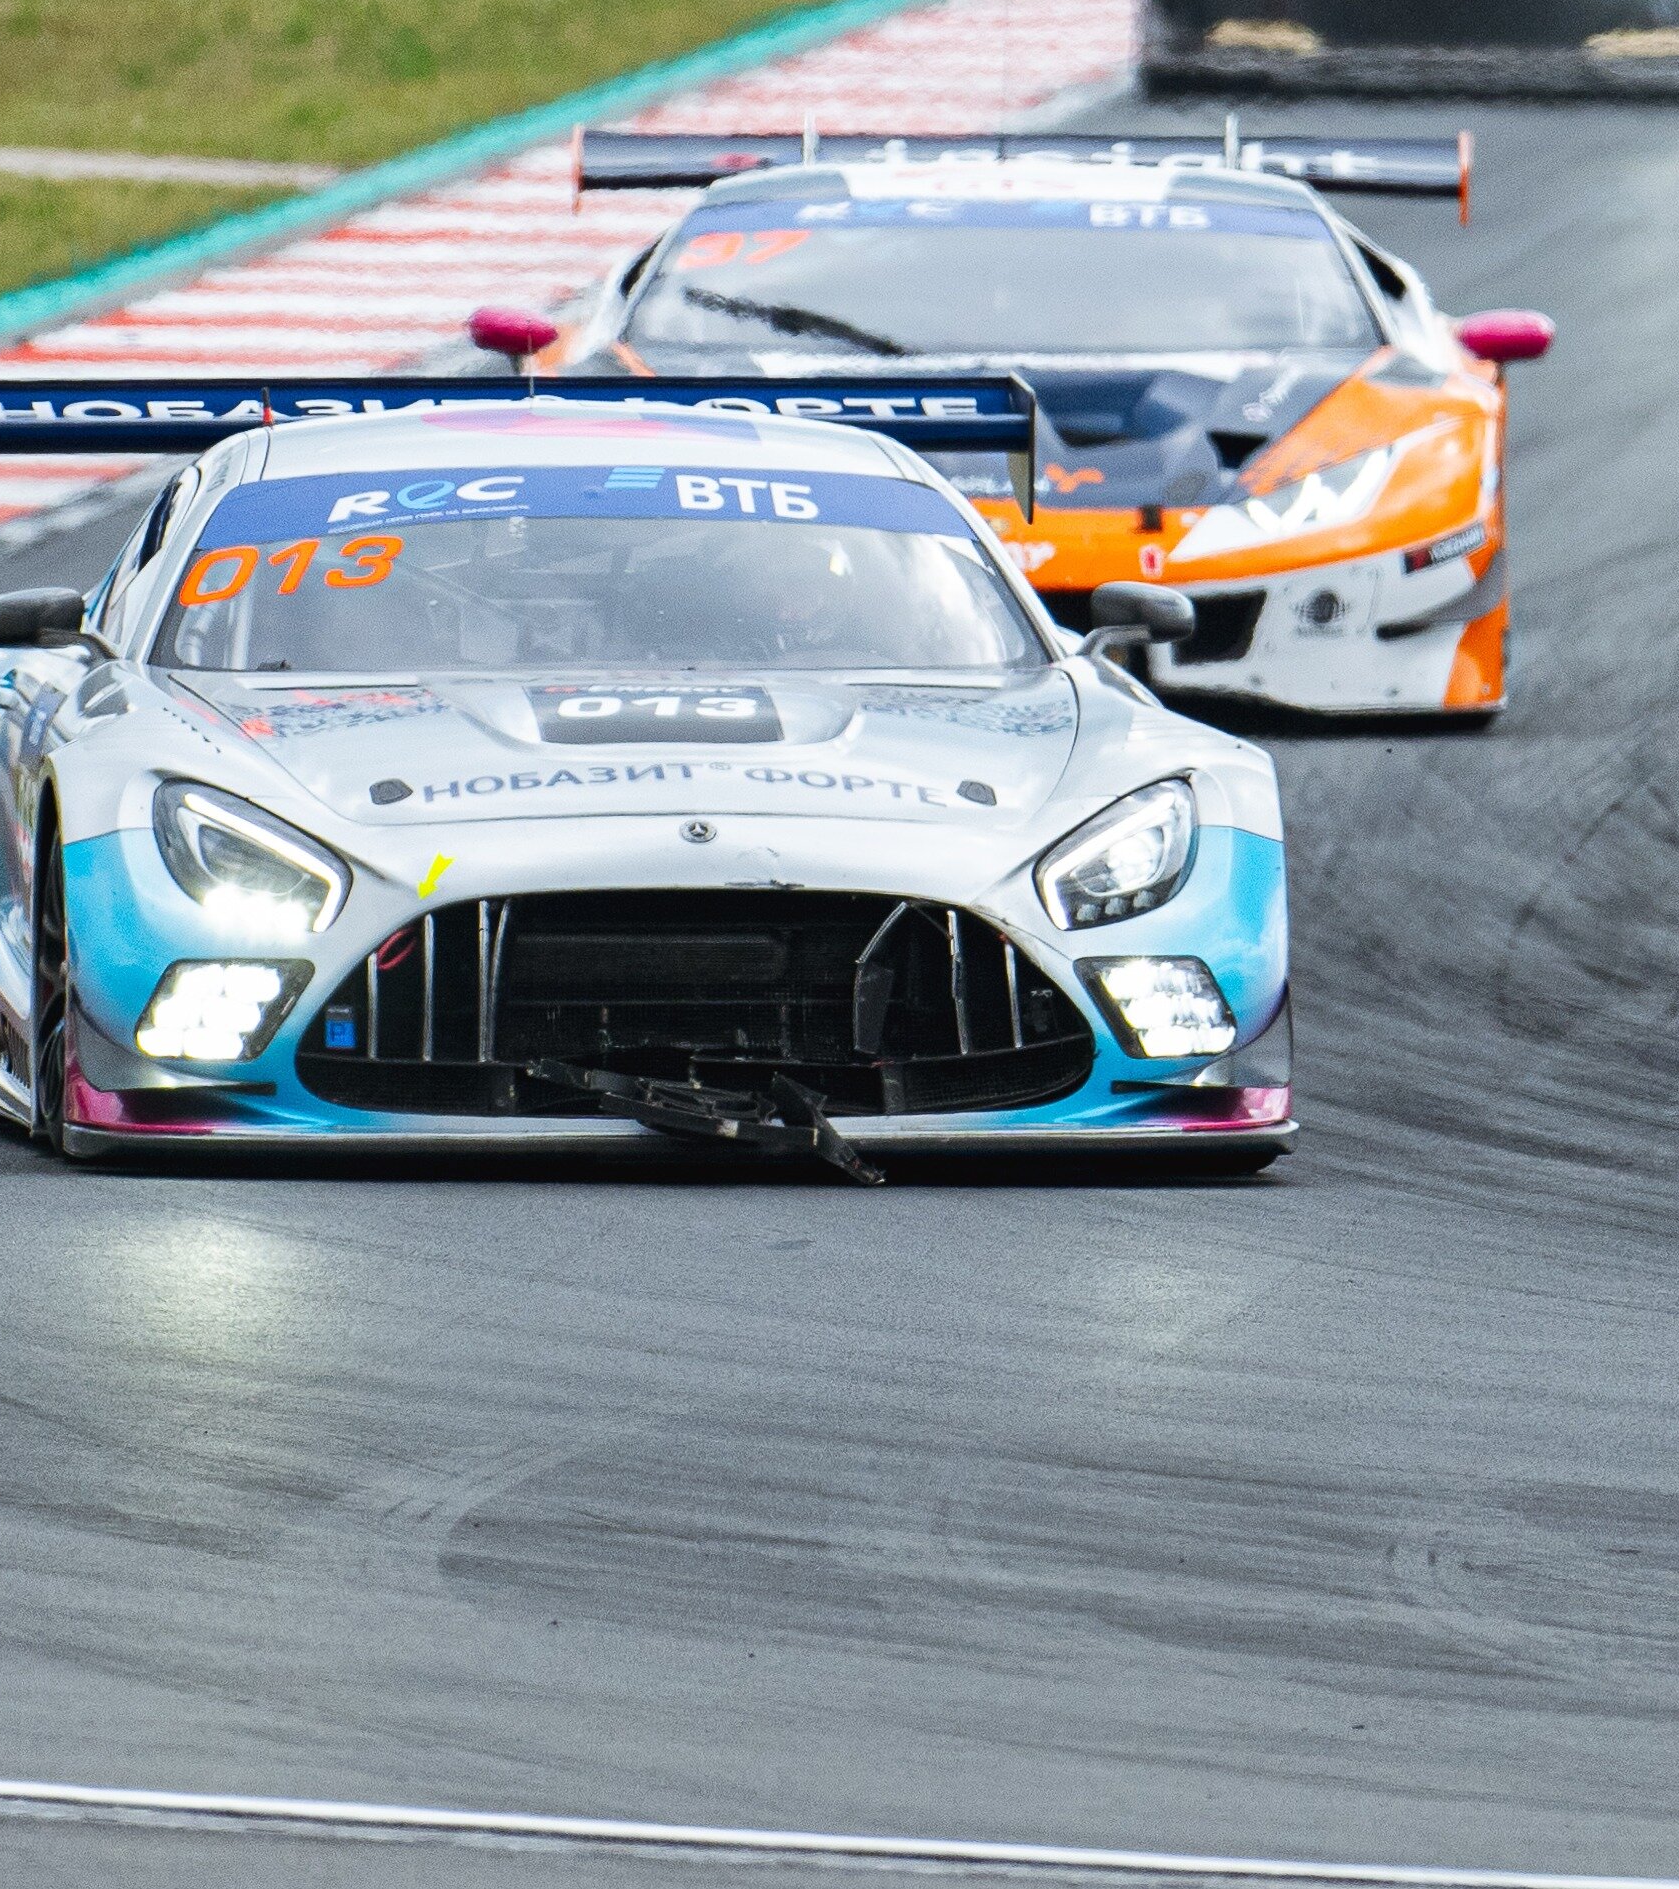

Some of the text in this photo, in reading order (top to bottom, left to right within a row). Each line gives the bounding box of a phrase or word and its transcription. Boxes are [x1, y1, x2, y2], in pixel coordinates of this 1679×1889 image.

[674, 473, 820, 521] ВТБ
[178, 535, 404, 607] 013
[556, 695, 759, 719] 013
[744, 766, 948, 808] ФОРТЕ
